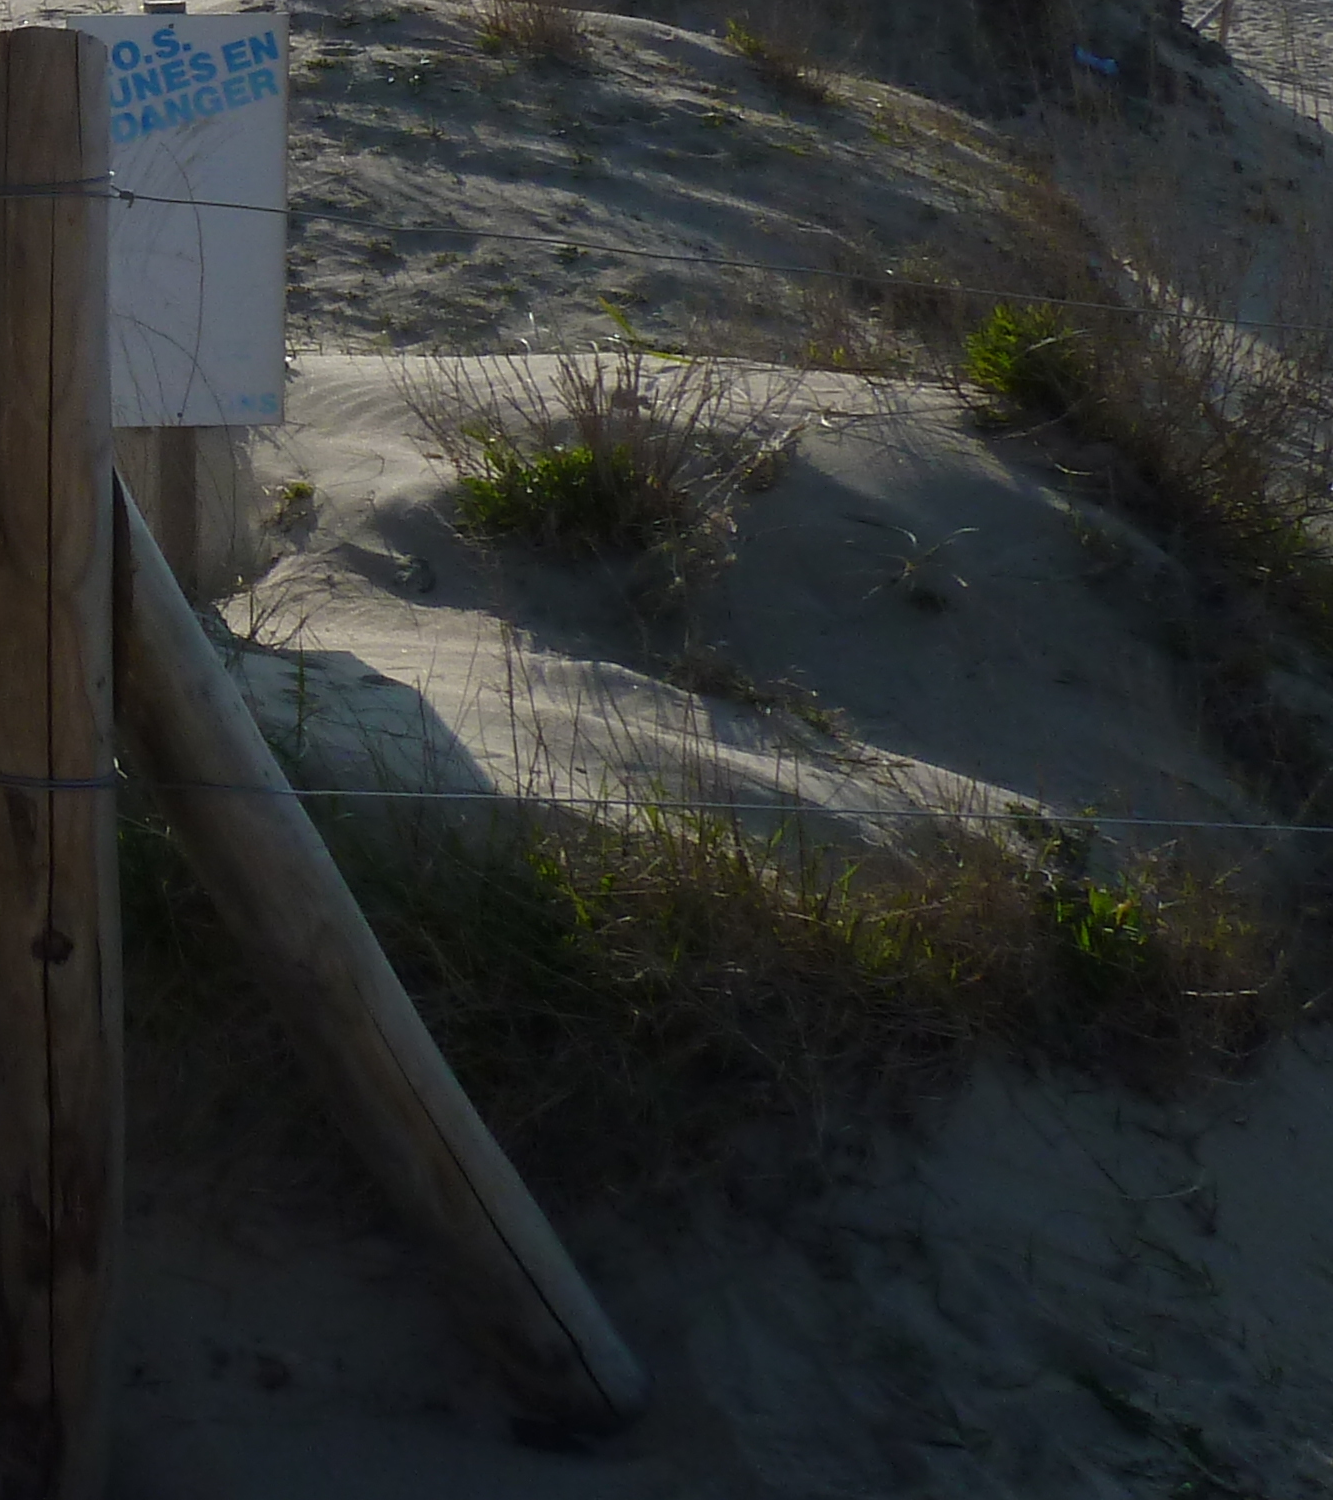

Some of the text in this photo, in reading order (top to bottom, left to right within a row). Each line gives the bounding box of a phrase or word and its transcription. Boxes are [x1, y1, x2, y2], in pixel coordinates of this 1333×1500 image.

[110, 29, 281, 109] UNES EN
[110, 66, 281, 145] DANGER
